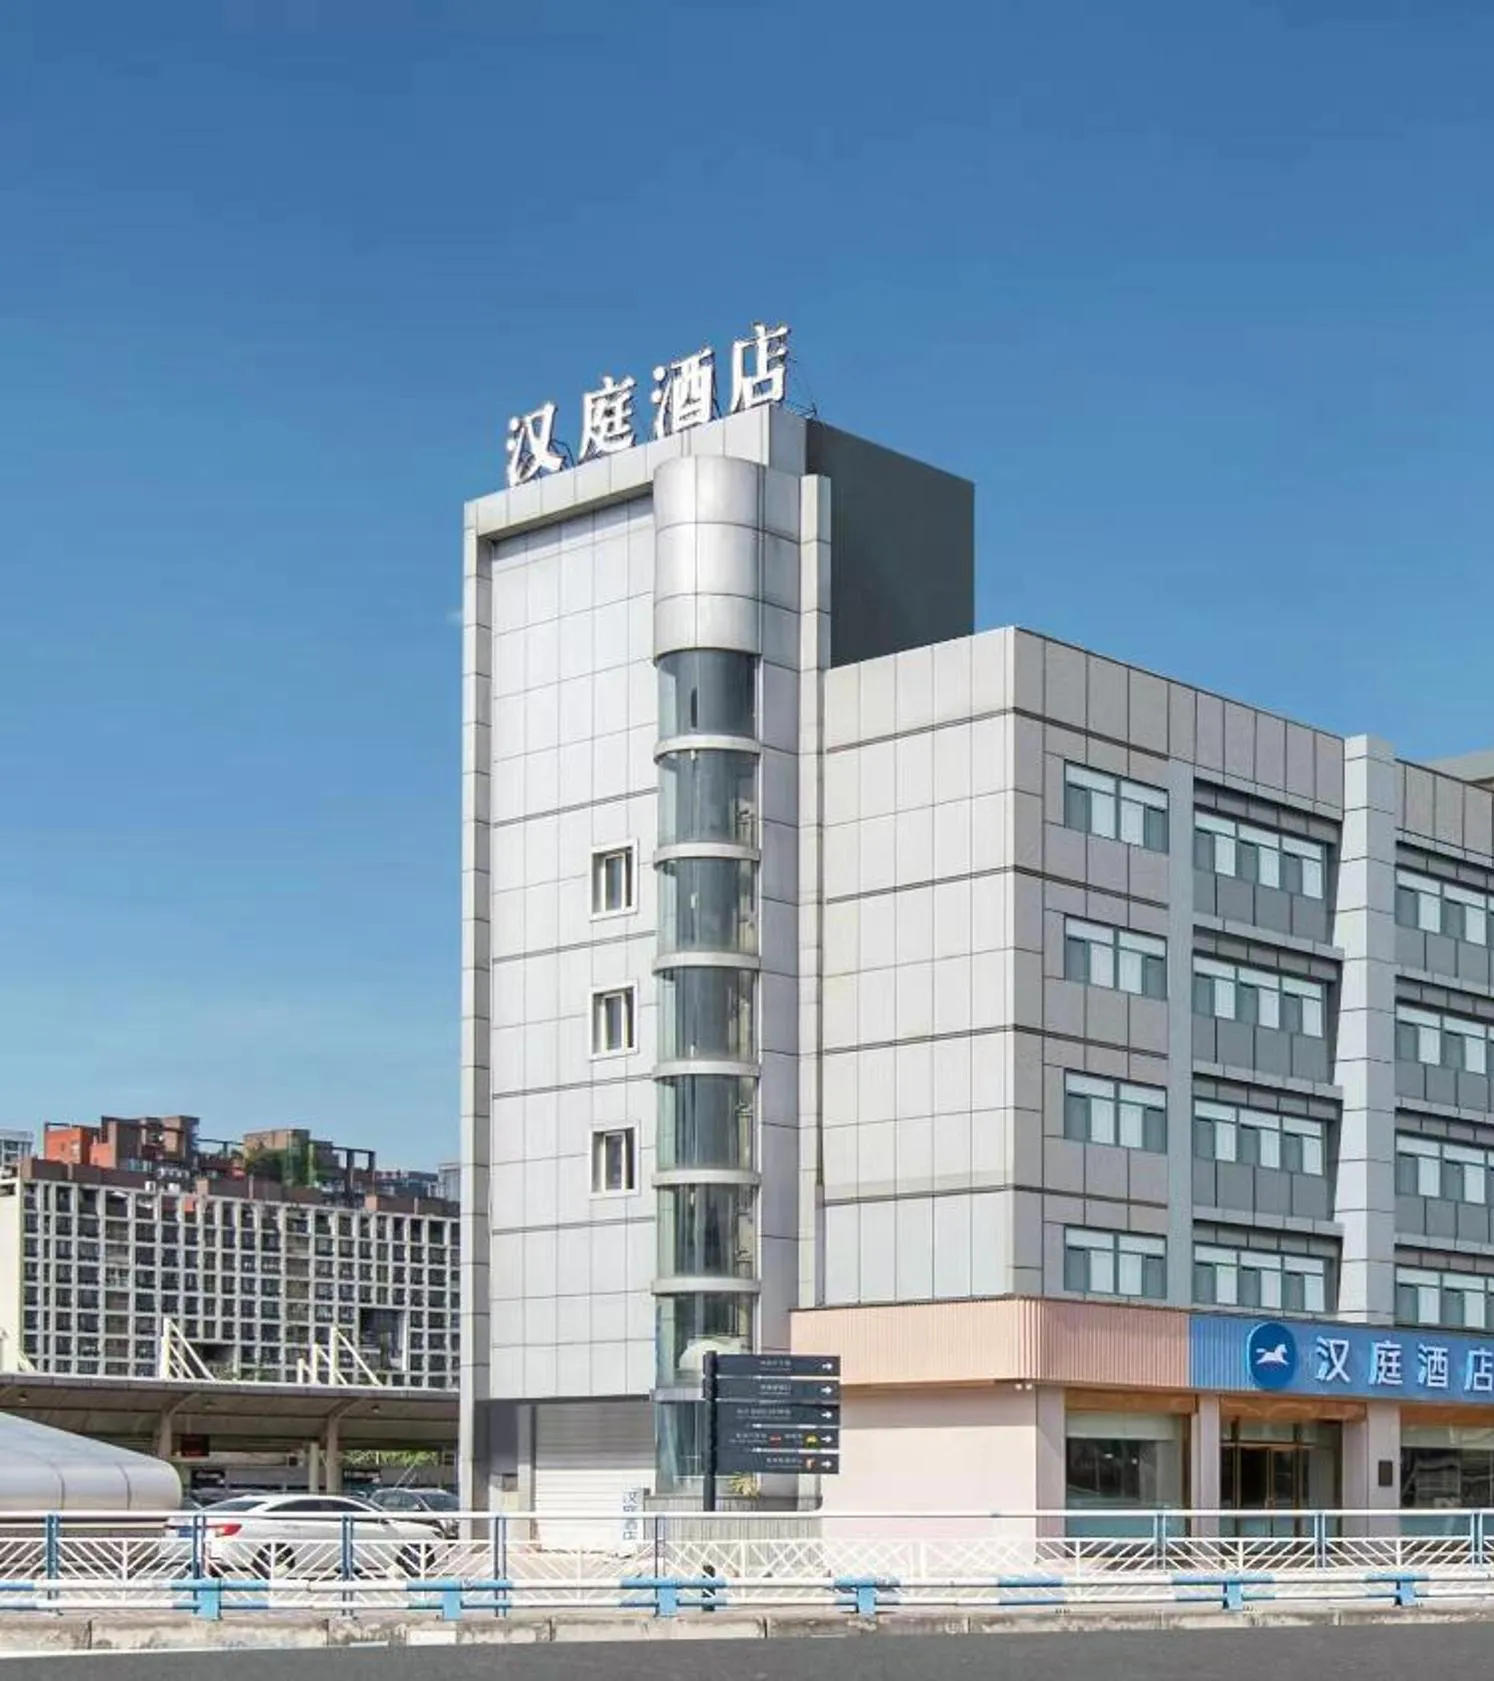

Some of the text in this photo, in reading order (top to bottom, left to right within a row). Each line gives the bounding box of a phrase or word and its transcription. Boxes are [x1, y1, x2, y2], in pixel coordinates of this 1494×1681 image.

[505, 323, 791, 486] 汉庭酒店
[1315, 1336, 1494, 1392] 汉庭酒店
